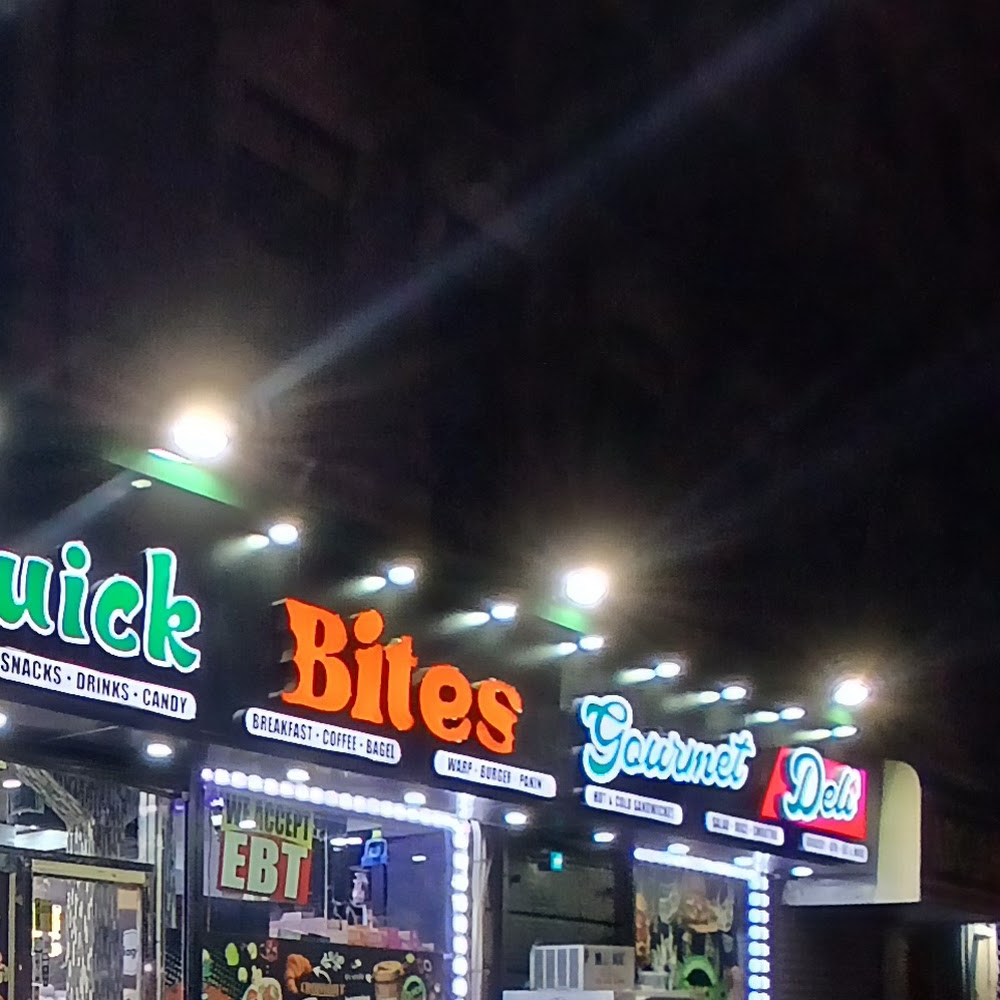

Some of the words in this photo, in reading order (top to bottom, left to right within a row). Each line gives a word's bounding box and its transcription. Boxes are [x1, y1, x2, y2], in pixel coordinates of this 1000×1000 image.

[0, 652, 62, 685] SNACKS
[76, 672, 129, 701] DRINKS
[142, 688, 188, 714] CANDY
[280, 597, 524, 754] Bites
[252, 713, 312, 741] BREAKFAST
[322, 728, 357, 751] COFFEE
[366, 738, 395, 760] BAGEL
[581, 694, 756, 790] Gourmet
[782, 746, 862, 822] Deli
[221, 831, 308, 899] EBT
